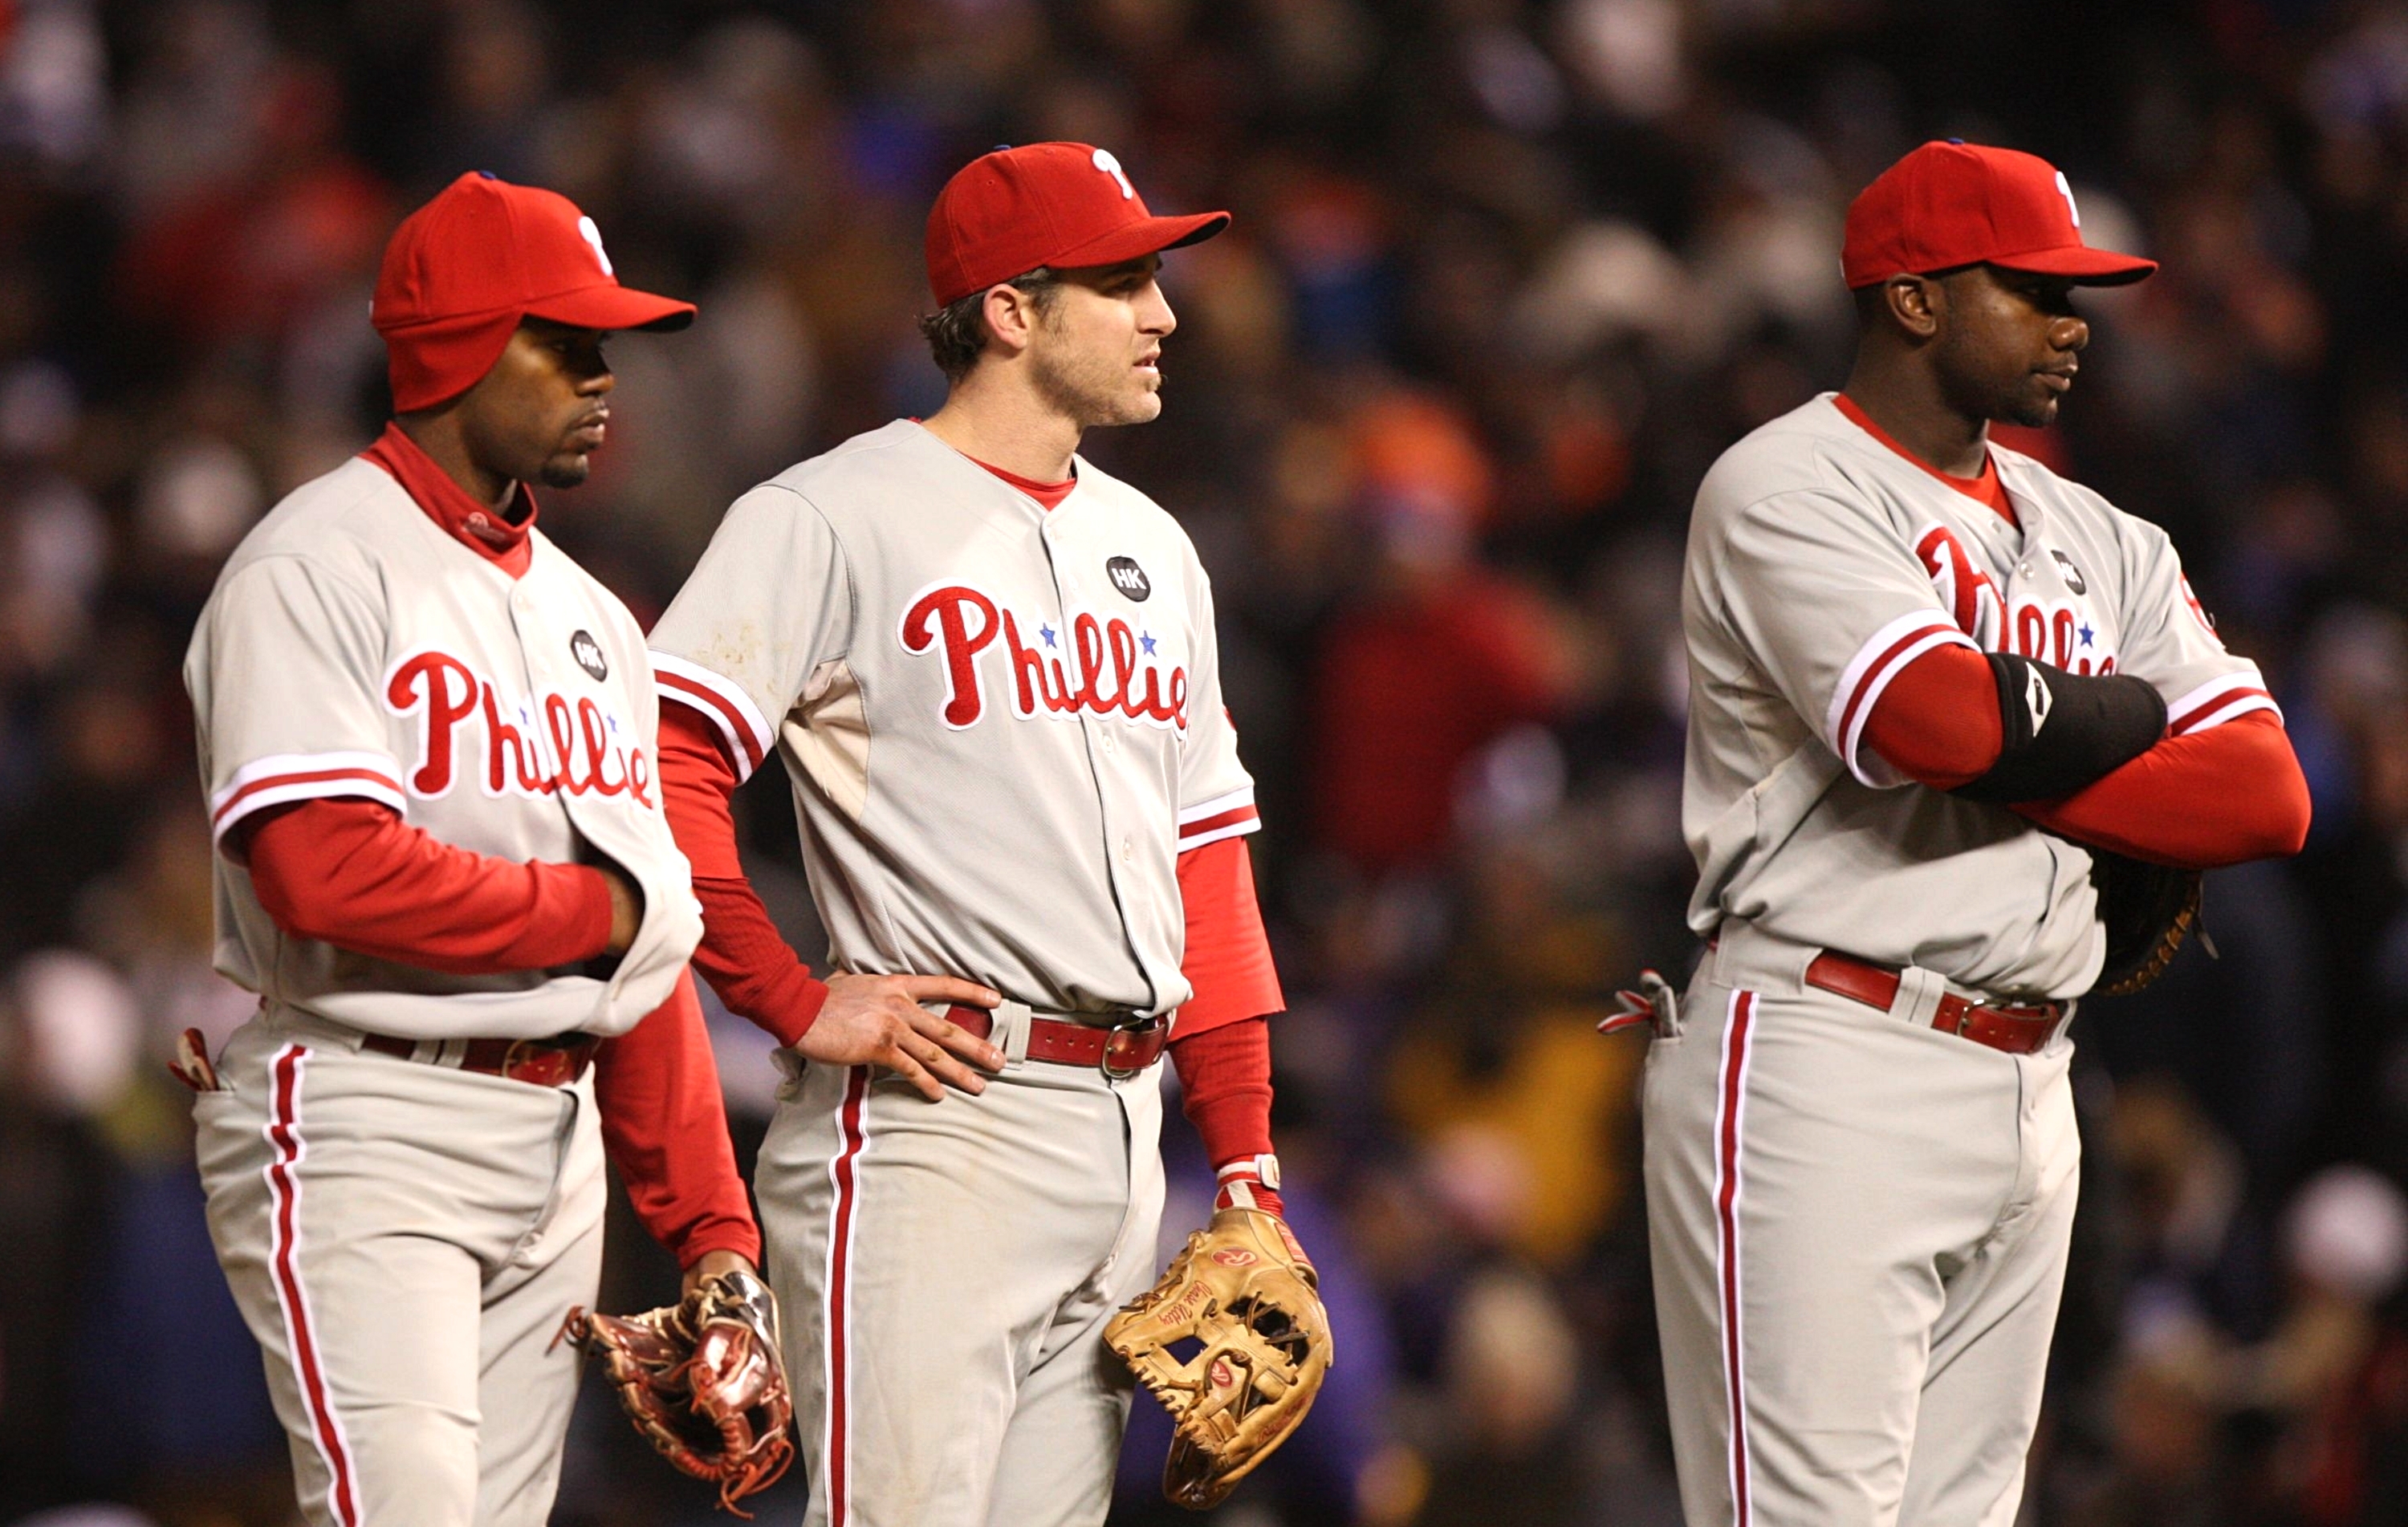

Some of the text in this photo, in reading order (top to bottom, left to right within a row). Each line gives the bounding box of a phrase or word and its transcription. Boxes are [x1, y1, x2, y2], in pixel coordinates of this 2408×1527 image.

[1111, 567, 1147, 590] HK
[574, 641, 605, 670] HK
[1157, 1304, 1193, 1326] Utley
